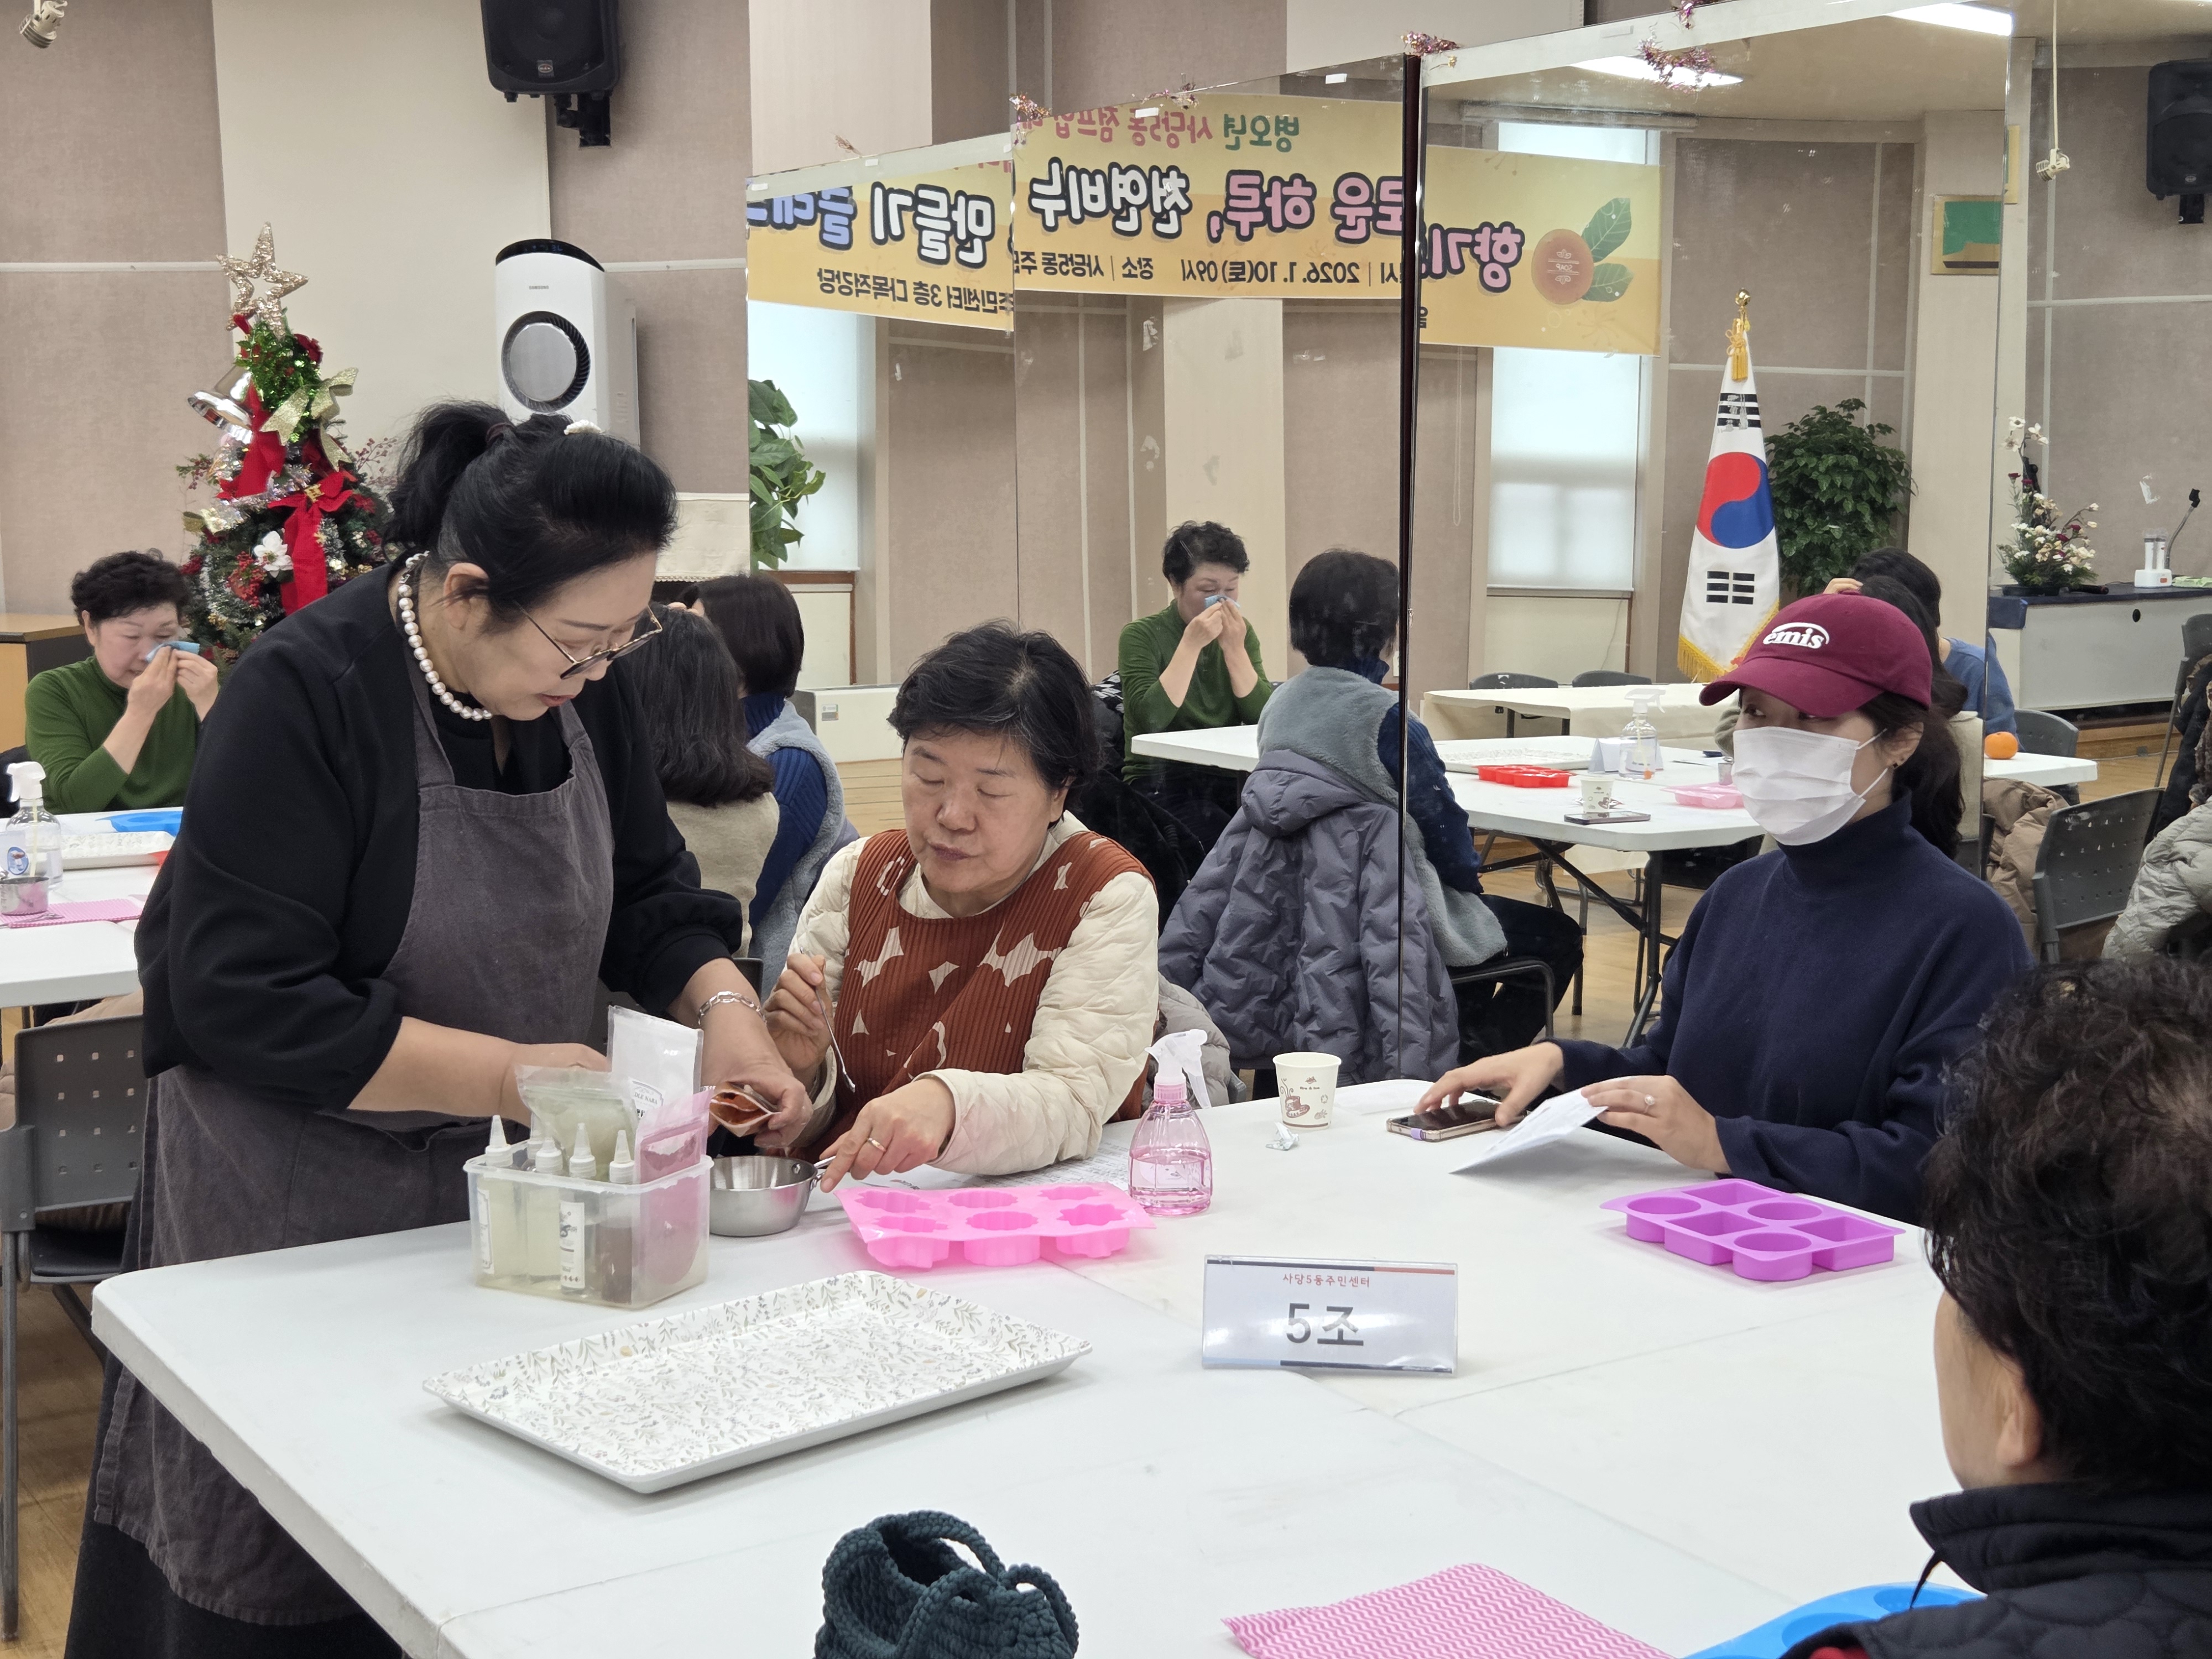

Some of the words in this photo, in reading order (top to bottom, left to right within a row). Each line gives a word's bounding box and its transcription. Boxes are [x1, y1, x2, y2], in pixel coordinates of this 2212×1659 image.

[1763, 628, 1824, 649] emis
[1282, 1273, 1370, 1288] 사당5동주민센터
[1286, 1303, 1364, 1345] 5조
